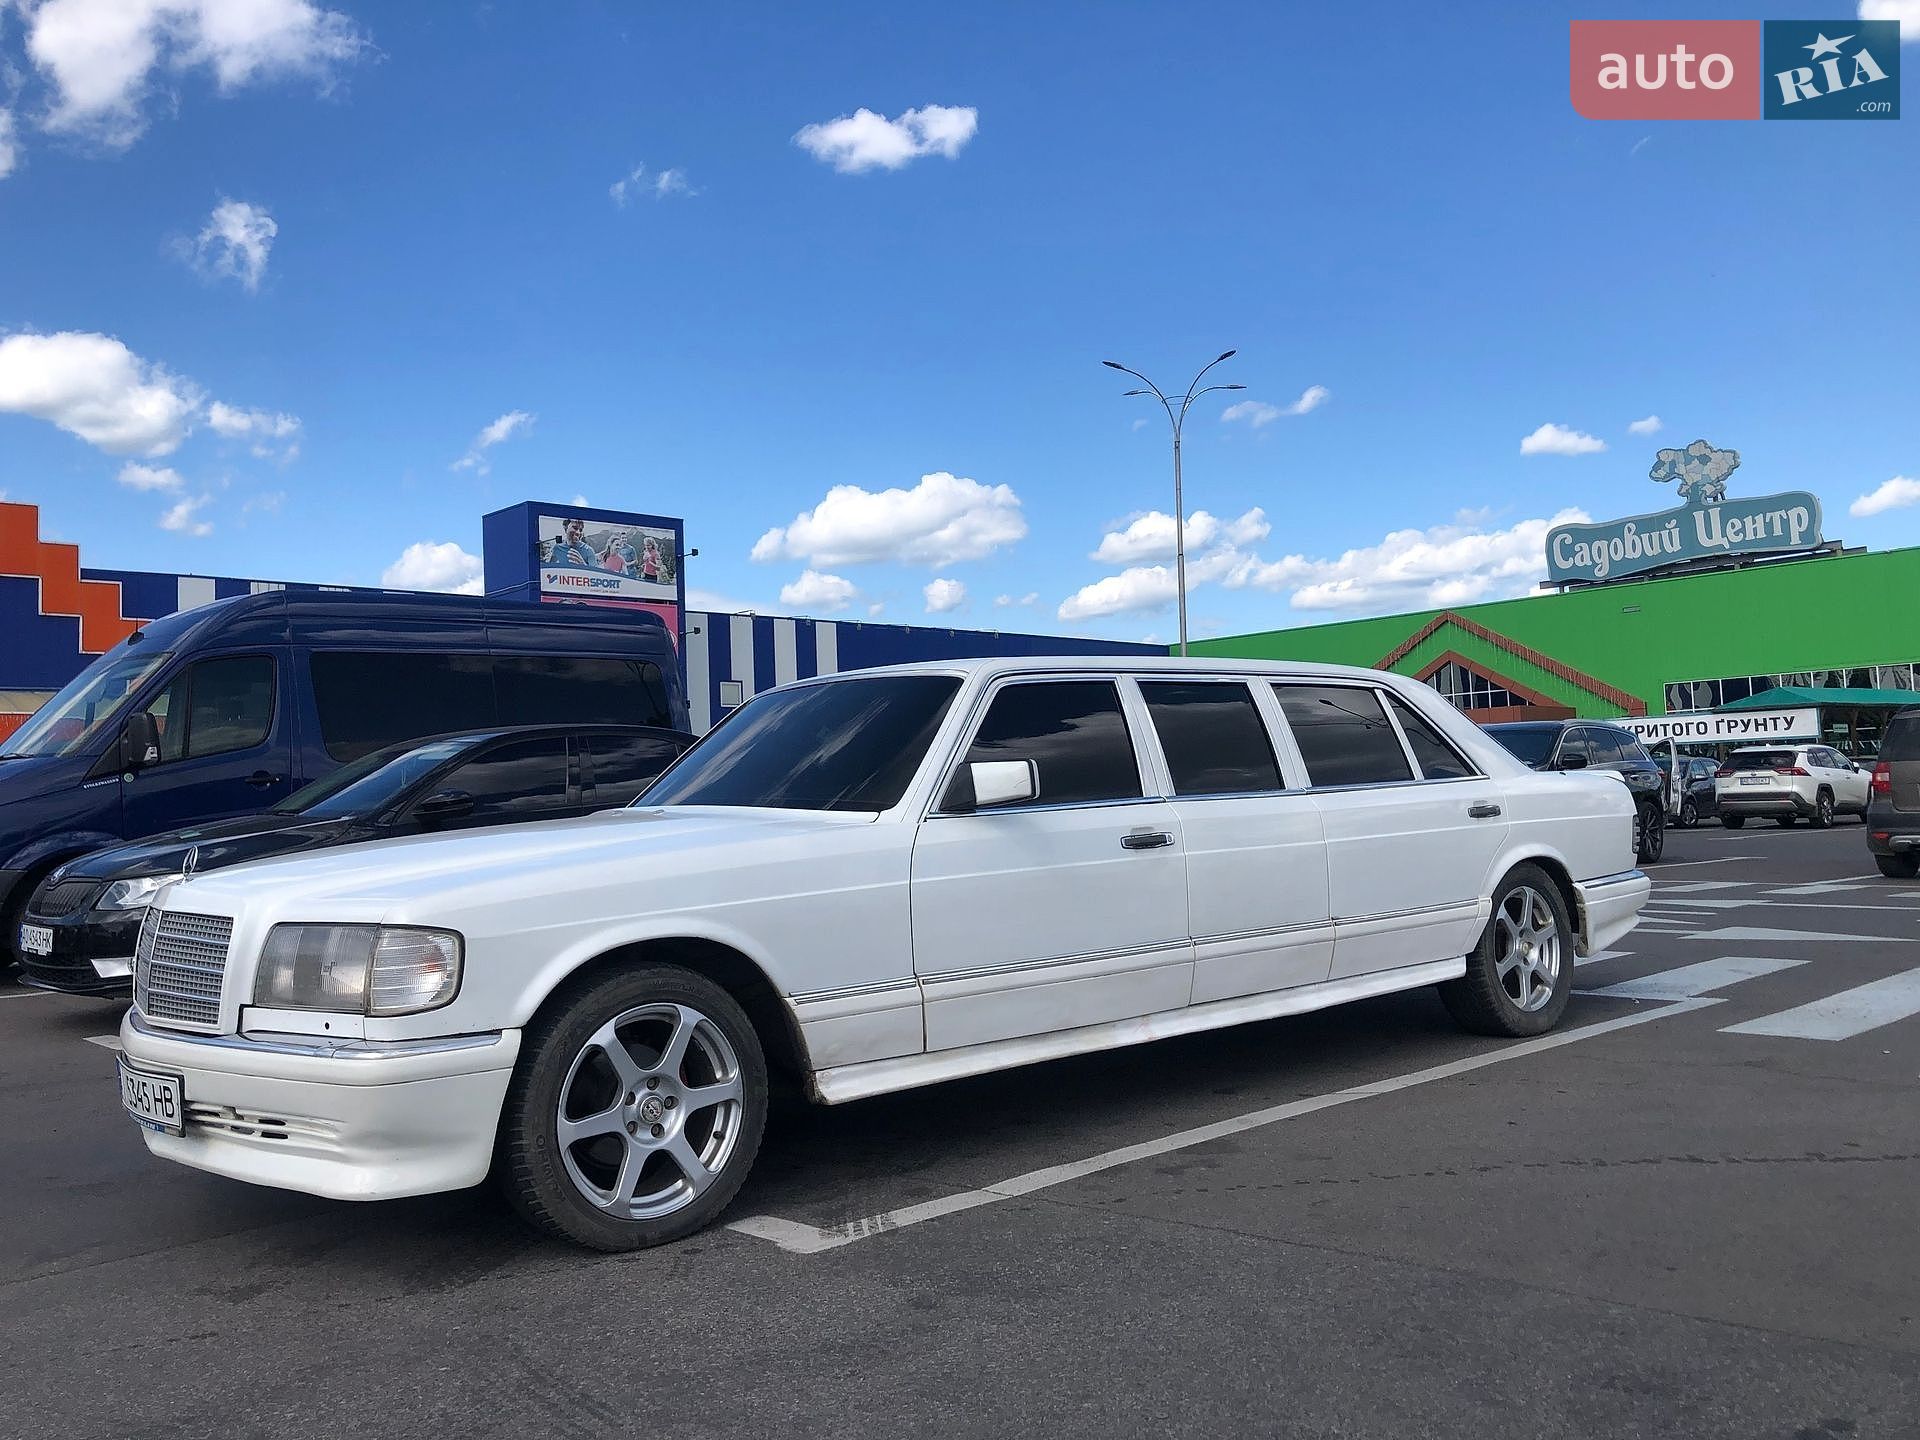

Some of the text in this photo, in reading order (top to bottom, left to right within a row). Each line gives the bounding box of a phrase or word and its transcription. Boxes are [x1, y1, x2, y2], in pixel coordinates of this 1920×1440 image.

[1552, 504, 1809, 577] Садовий Центр
[558, 574, 622, 589] INTERSPORT
[1715, 715, 1796, 735] ҐРУНТУ
[151, 1083, 175, 1118] HB
